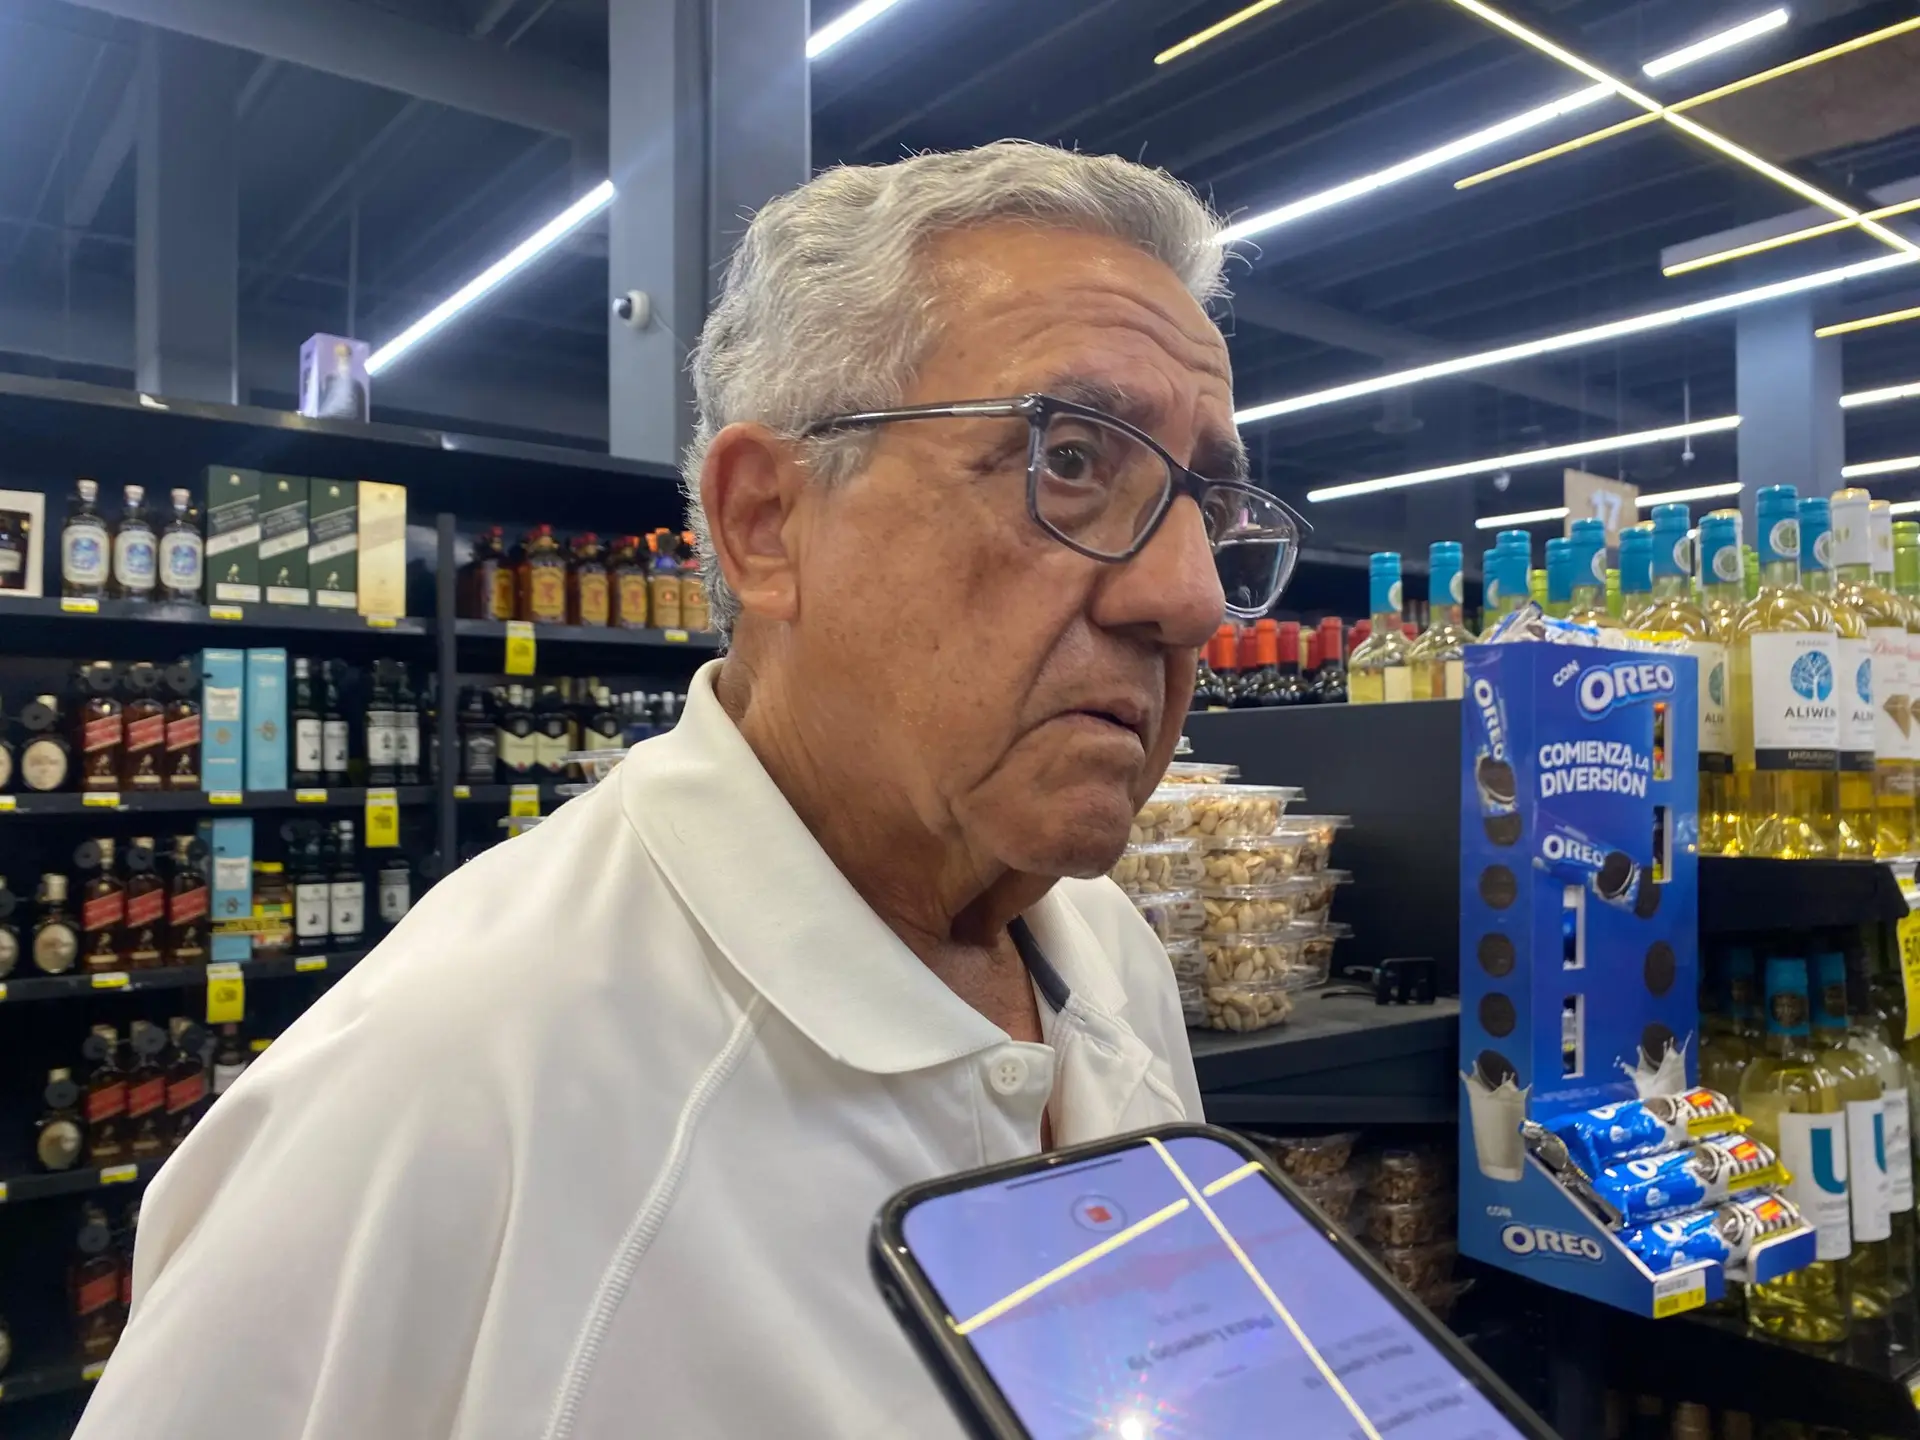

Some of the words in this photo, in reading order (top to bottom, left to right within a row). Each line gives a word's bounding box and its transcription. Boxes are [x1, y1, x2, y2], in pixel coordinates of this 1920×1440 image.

[1552, 659, 1581, 688] CON
[1580, 664, 1675, 712] OREO
[1474, 678, 1505, 760] OREO
[1539, 741, 1633, 768] COMIENZA
[1634, 752, 1649, 772] LA
[1540, 762, 1648, 799] DIVERSIÓN
[1542, 833, 1605, 867] OREO
[1502, 1225, 1602, 1260] OREO
